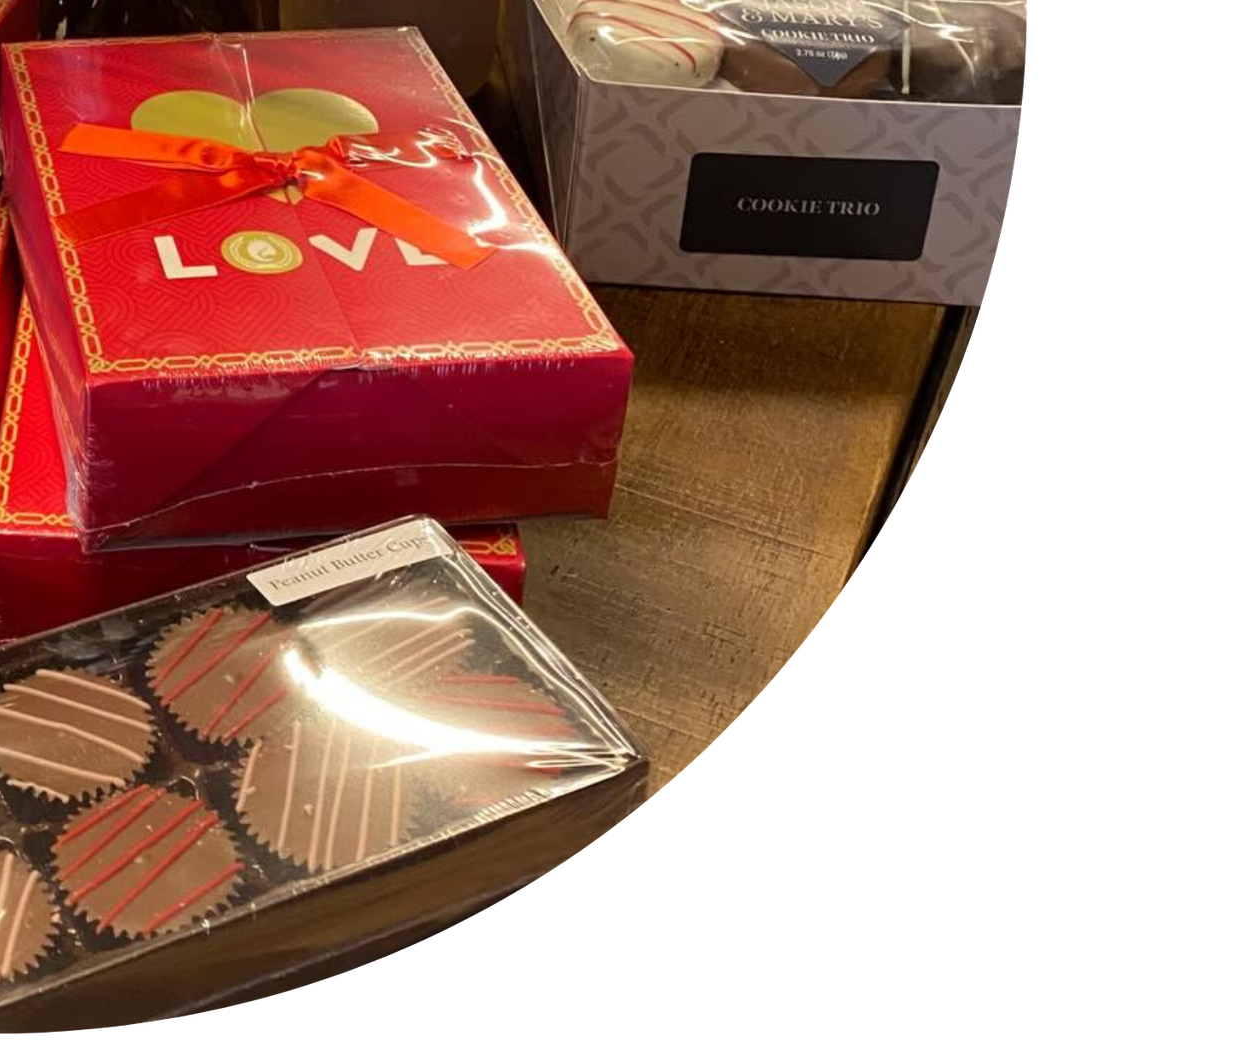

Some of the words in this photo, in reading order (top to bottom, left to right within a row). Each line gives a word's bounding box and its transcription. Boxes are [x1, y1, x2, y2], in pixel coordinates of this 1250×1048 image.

[741, 8, 763, 23] &
[770, 10, 883, 29] MARY'S
[760, 29, 828, 42] COOKIE
[829, 32, 875, 43] TRIO
[737, 198, 822, 214] COOKIE
[826, 200, 881, 216] TRIO
[268, 565, 331, 591] Peanut
[330, 547, 384, 571] Butter
[386, 535, 432, 553] Cups
